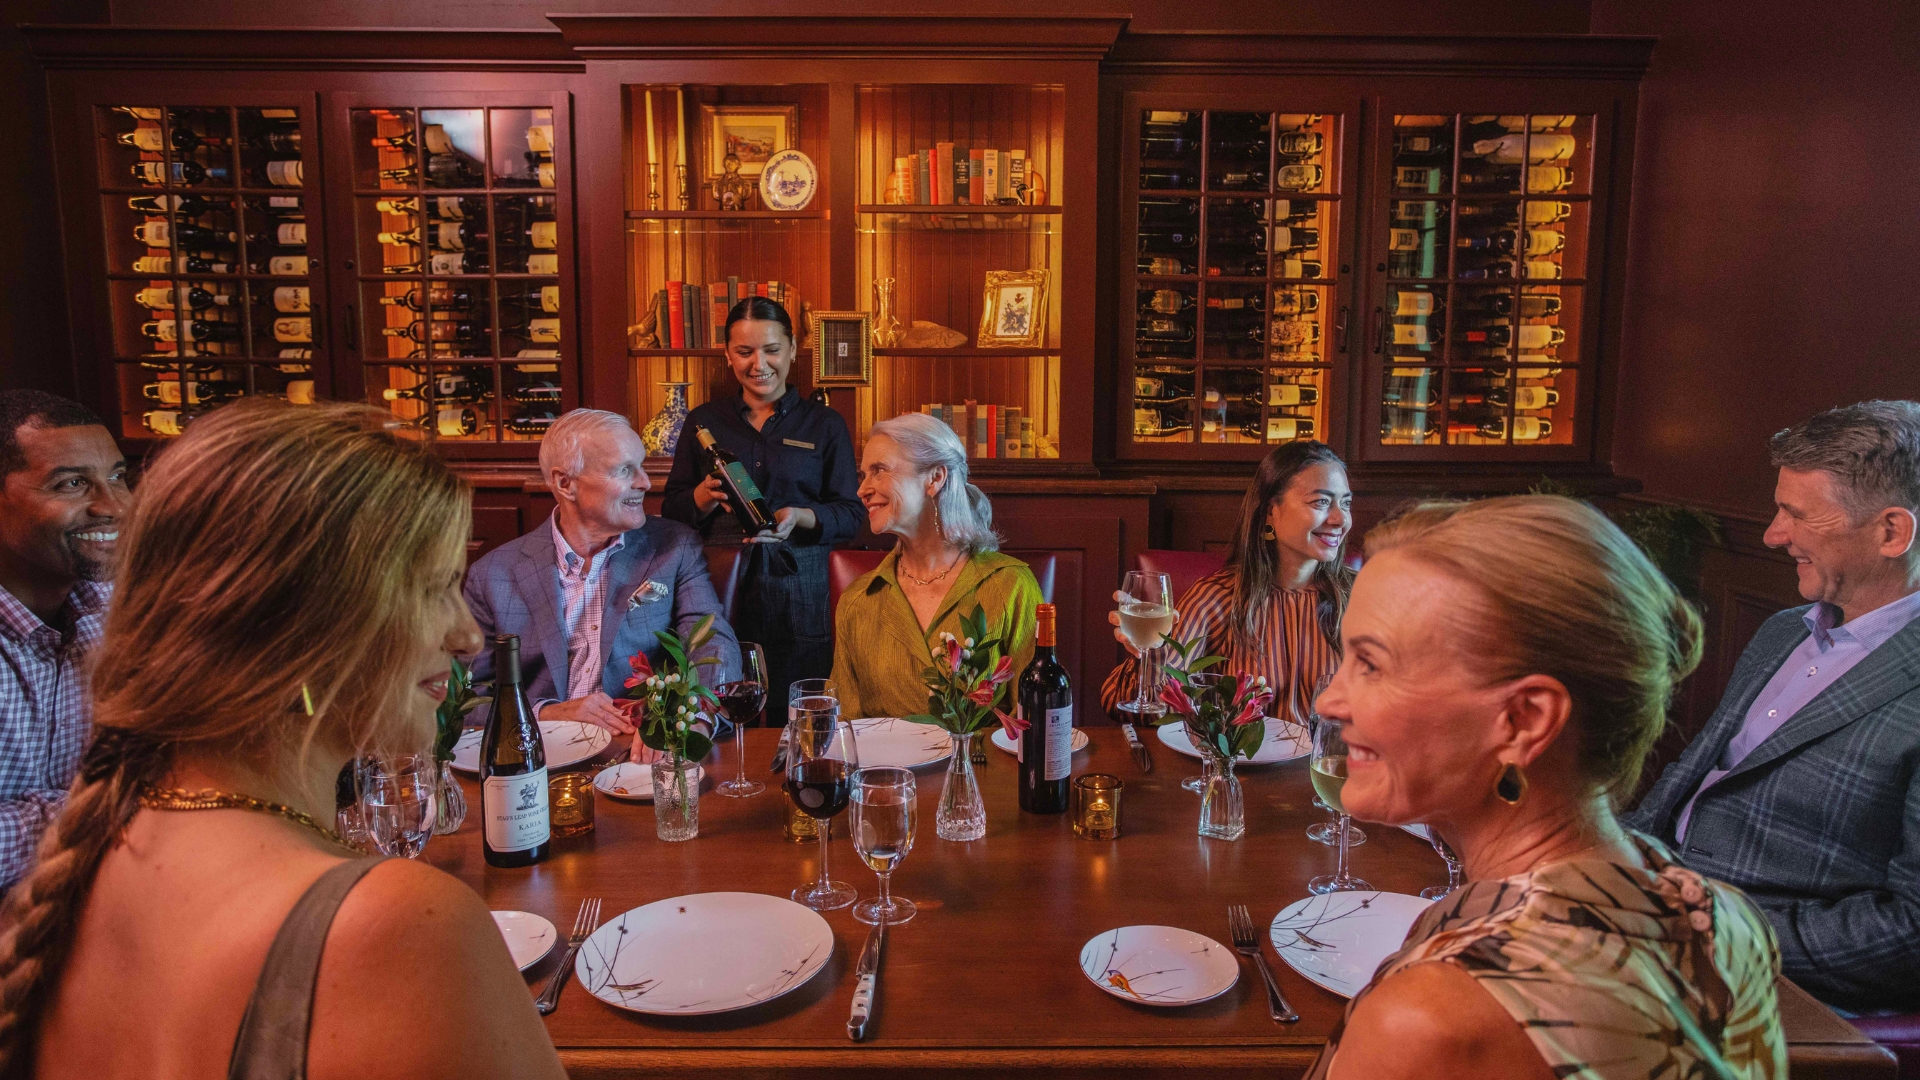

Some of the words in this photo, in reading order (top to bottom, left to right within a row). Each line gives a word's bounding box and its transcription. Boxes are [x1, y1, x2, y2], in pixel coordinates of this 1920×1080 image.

[514, 813, 527, 821] LEAP
[528, 809, 539, 817] WINE
[518, 819, 542, 831] KARIA
